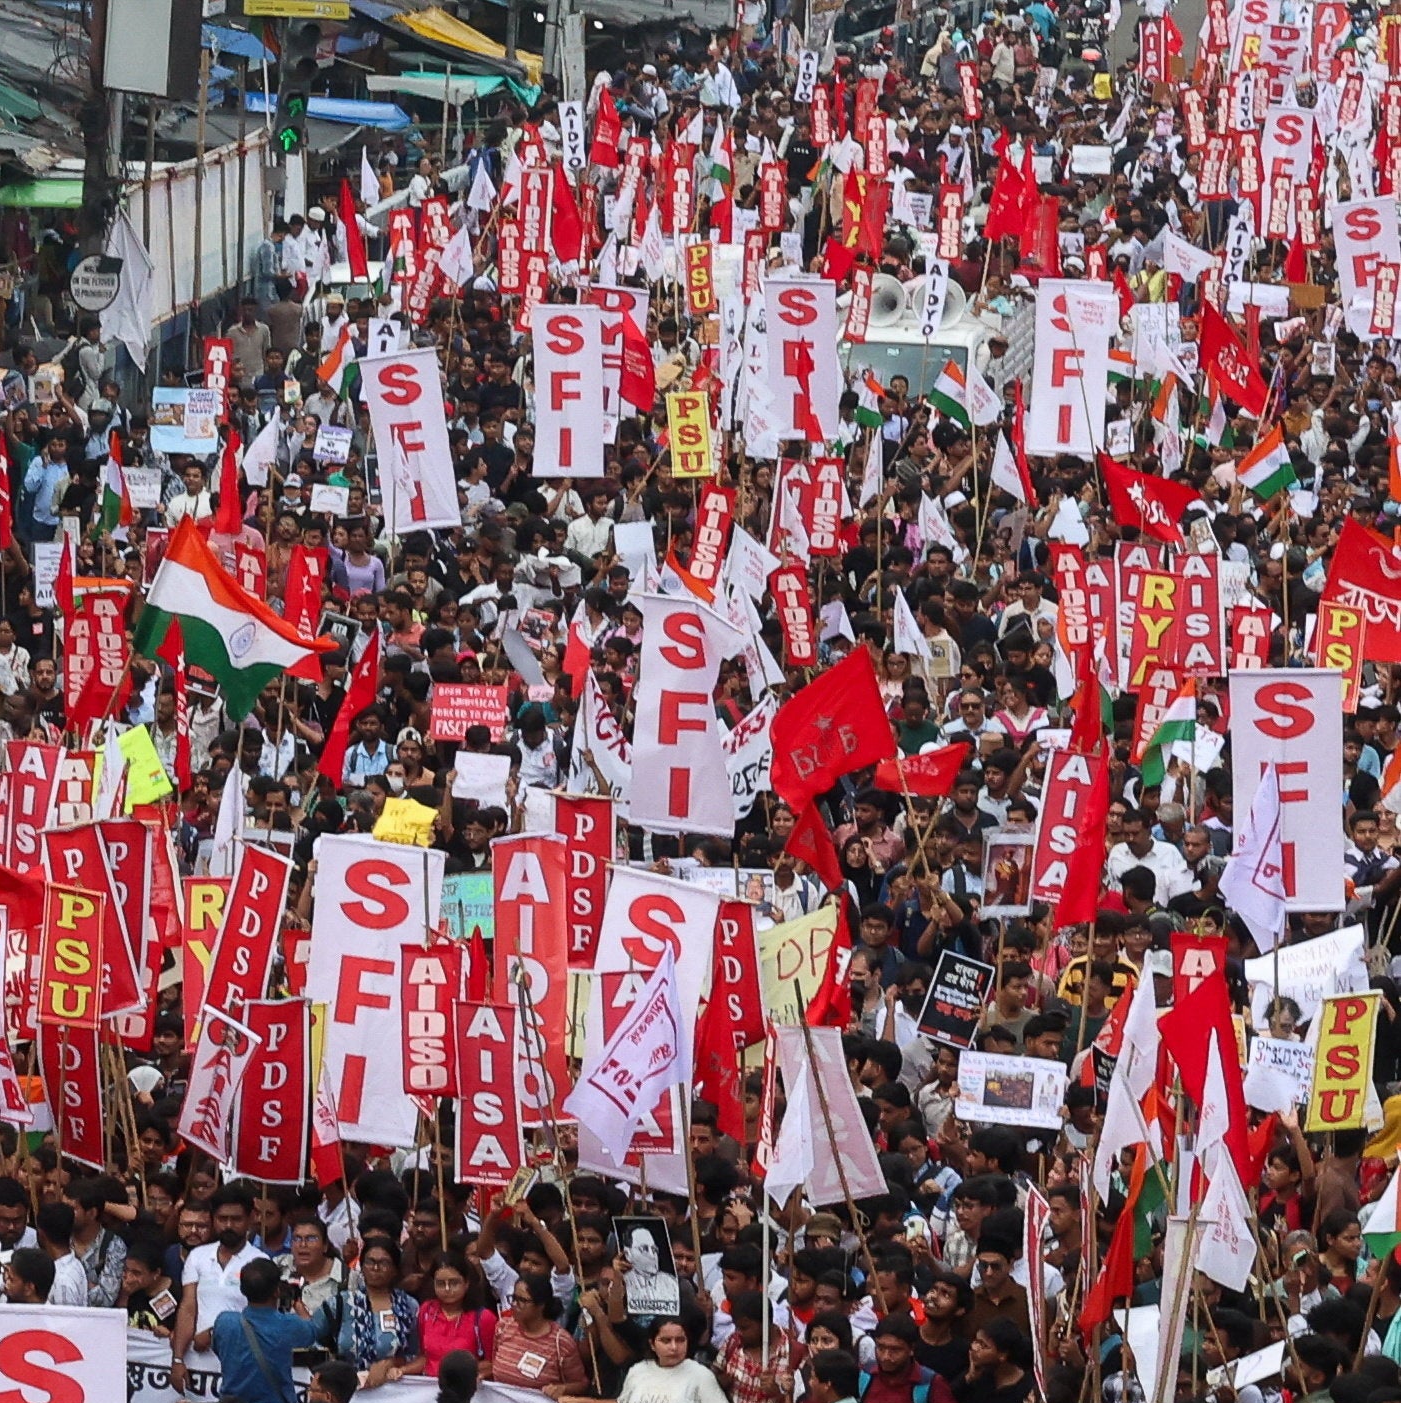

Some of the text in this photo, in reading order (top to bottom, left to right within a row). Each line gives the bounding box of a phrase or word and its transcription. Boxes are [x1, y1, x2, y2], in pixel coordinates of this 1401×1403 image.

[564, 106, 584, 168] AIDYO
[1240, 74, 1252, 128] AIDYO
[1240, 133, 1259, 192] AIDSO
[1270, 177, 1291, 234] AIDSO
[941, 192, 962, 258] AIDSO
[1223, 221, 1249, 283] AIDYO
[688, 247, 711, 310] PSU
[850, 269, 869, 337] AIDSO
[922, 263, 943, 336] AIDYO
[1374, 266, 1397, 328] AIDSO
[546, 315, 586, 468] SFI
[378, 364, 427, 522] SFI
[677, 399, 705, 474] PSU
[690, 493, 727, 580] AIDSO
[811, 466, 840, 549] AIDSO
[93, 599, 119, 684] AIDSO
[777, 576, 810, 659] AIDSO
[1056, 554, 1089, 644] AIDSO
[1185, 555, 1213, 667] AISA
[432, 708, 468, 718] FORCED
[660, 612, 708, 818] SFI
[1037, 756, 1092, 889] AISA
[1253, 682, 1316, 897] SFI
[572, 812, 596, 952] PDSF
[51, 891, 94, 1018] PSU
[226, 867, 269, 1011] PDSF
[501, 851, 557, 1109] AIDSO
[334, 859, 410, 1125] SFI
[409, 957, 448, 1090] AIDSO
[258, 1022, 289, 1163] PDSF
[465, 1012, 514, 1169] AISA
[1318, 999, 1367, 1125] PSU
